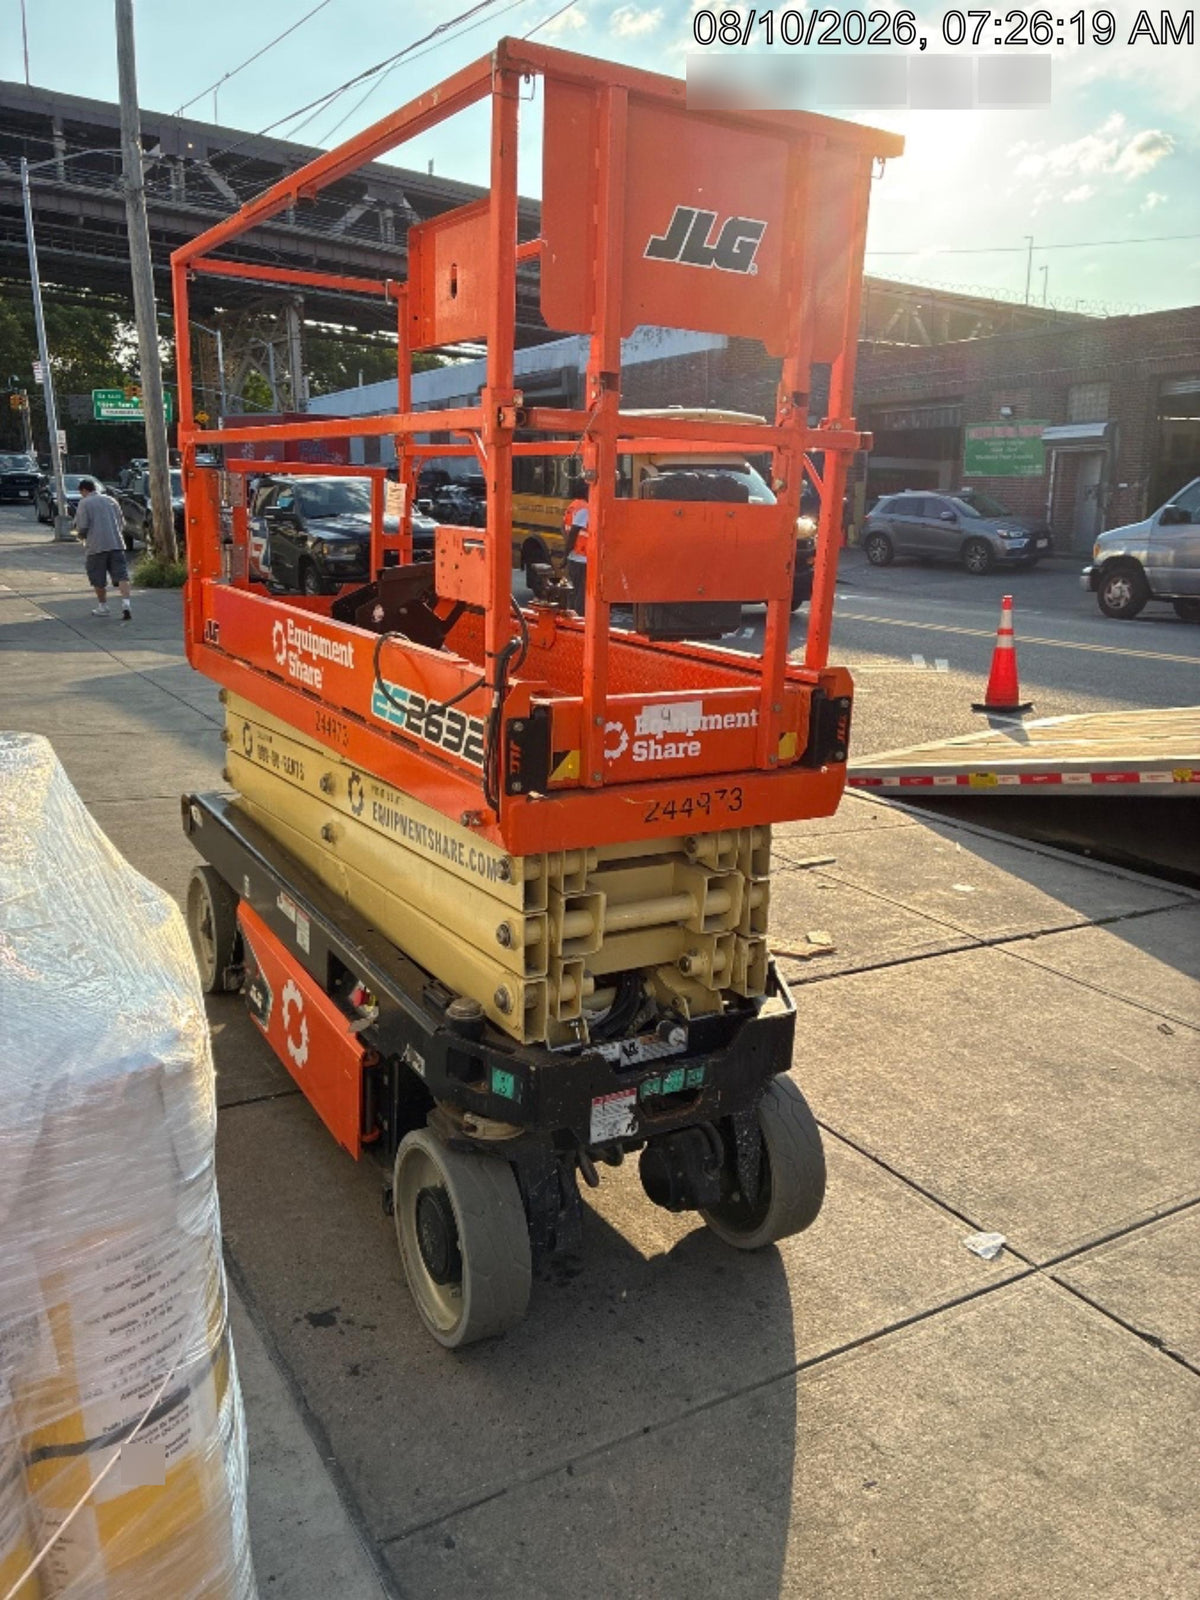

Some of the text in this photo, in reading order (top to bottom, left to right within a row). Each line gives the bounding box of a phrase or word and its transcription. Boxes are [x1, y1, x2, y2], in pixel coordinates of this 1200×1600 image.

[643, 205, 768, 274] JLG
[287, 618, 355, 669] Equipment
[288, 650, 323, 689] Share
[632, 740, 702, 762] Share
[643, 787, 744, 823] 244973
